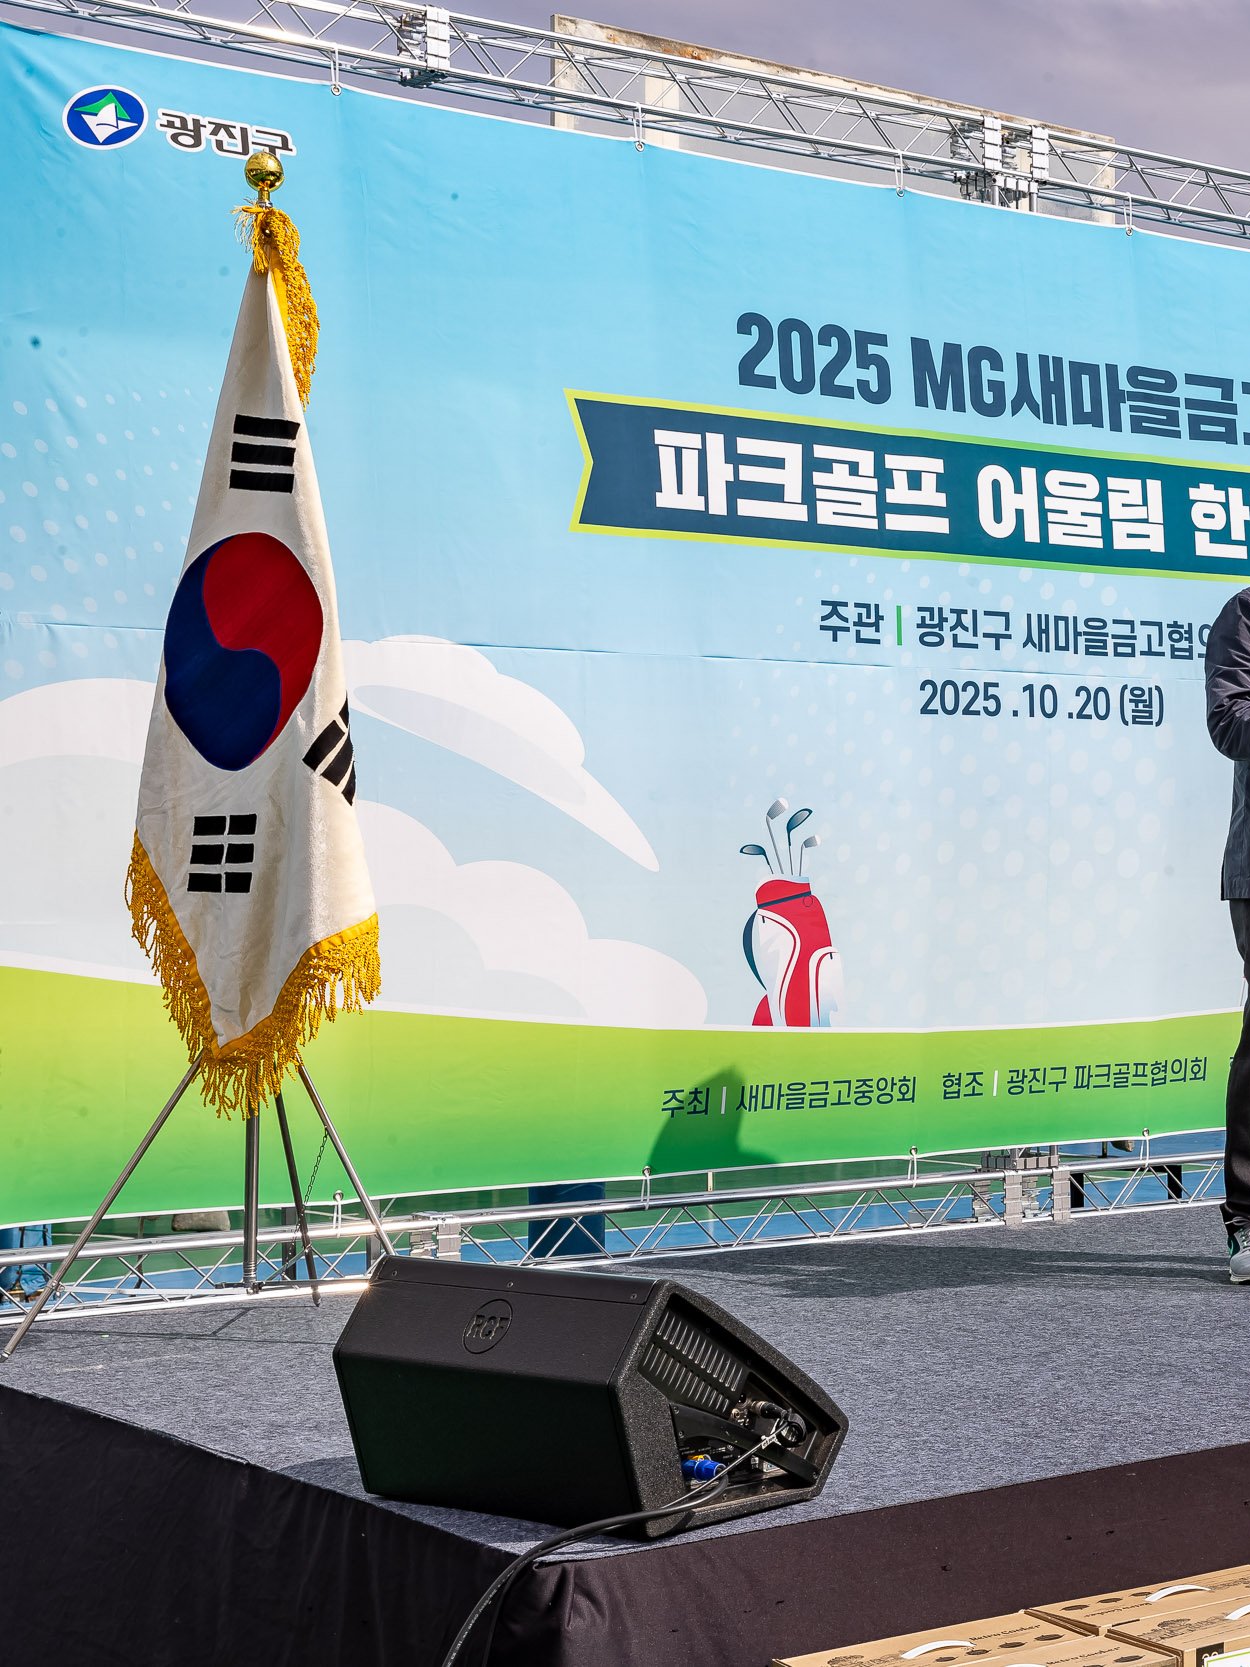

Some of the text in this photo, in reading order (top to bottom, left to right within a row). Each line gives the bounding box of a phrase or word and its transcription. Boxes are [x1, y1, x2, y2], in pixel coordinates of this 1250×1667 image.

[160, 112, 293, 157] 광진구
[737, 312, 892, 405] 2025
[653, 429, 950, 535] 파크골프
[976, 464, 1166, 553] 어울림
[820, 600, 885, 645] 주관
[916, 606, 1013, 651] 광진구
[920, 679, 1001, 717] 2025
[1119, 683, 1165, 728] (월)
[661, 1056, 1208, 1119] 주최 새마을금고중앙회 협조 광진구 파크골프협의회
[466, 1314, 510, 1340] RCF
